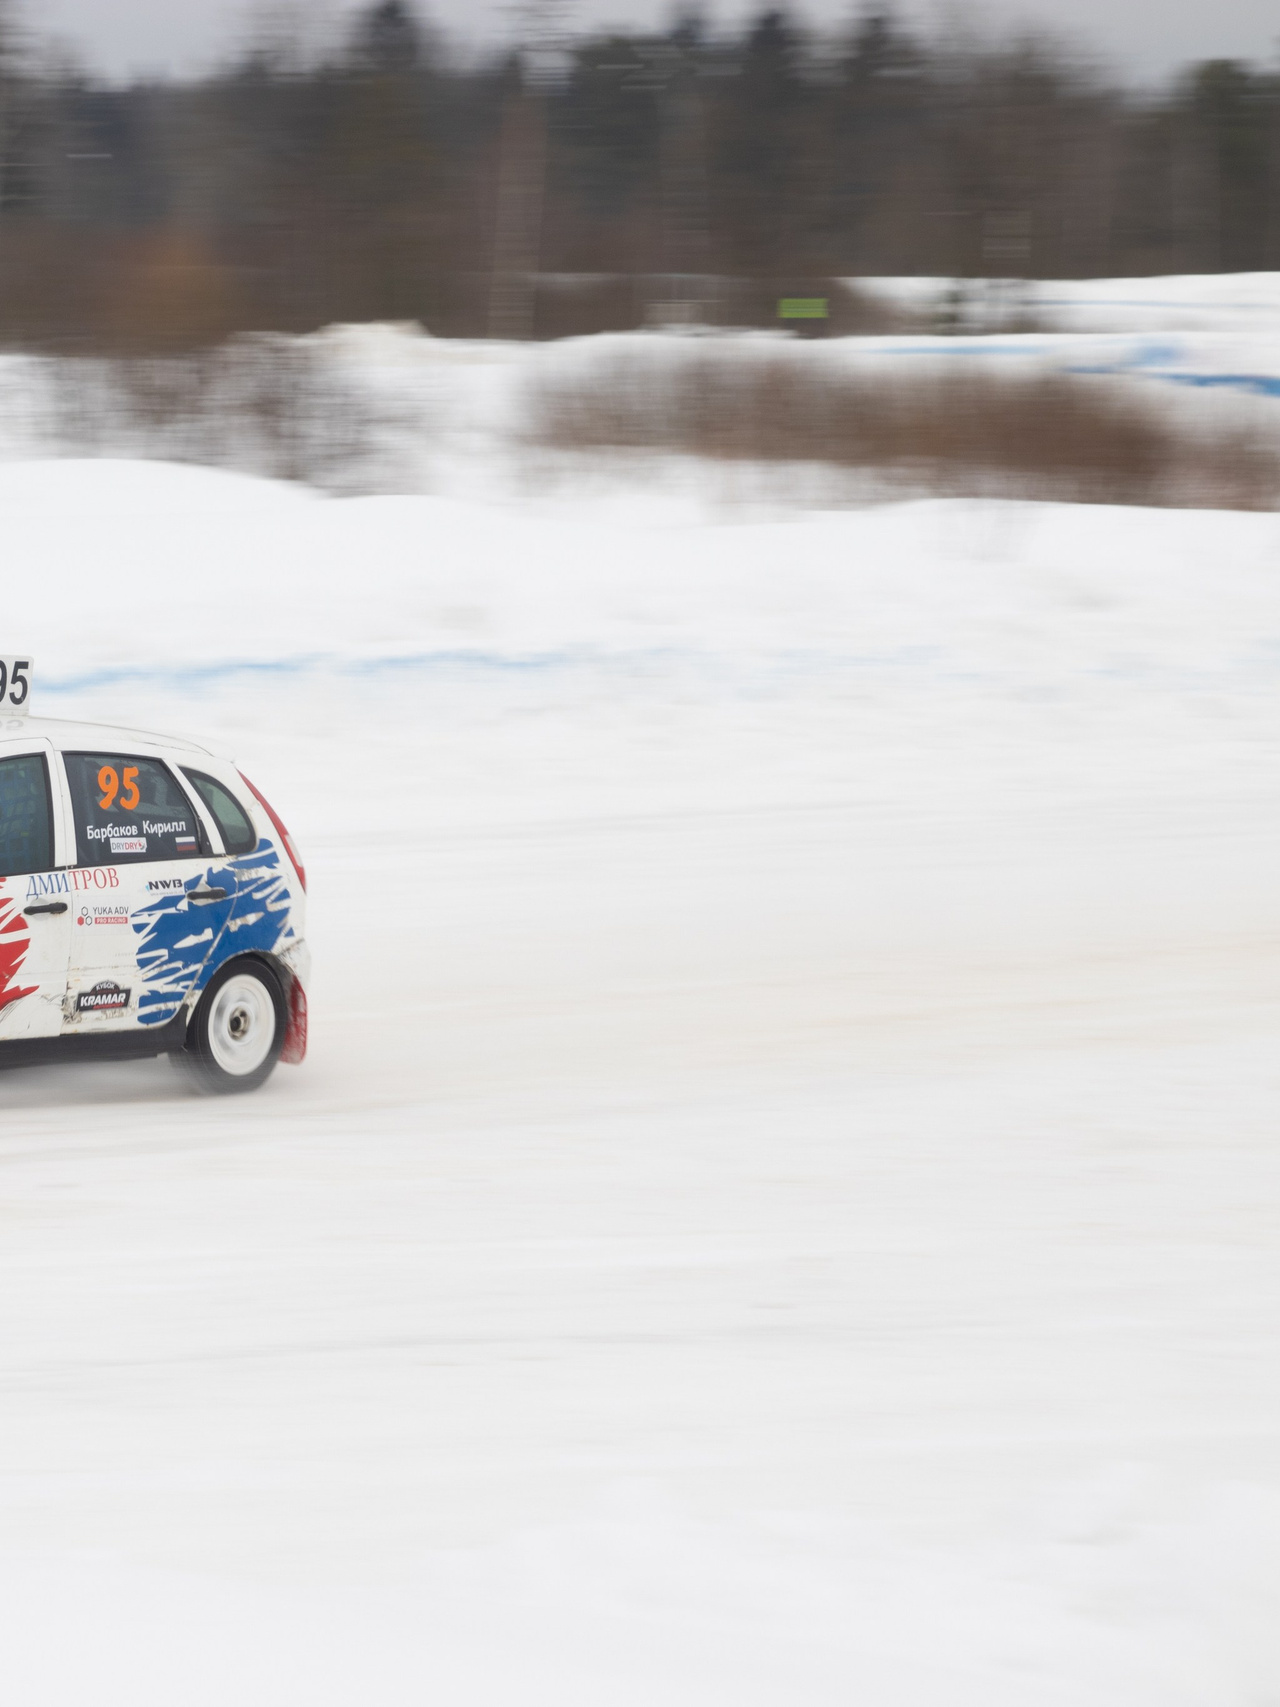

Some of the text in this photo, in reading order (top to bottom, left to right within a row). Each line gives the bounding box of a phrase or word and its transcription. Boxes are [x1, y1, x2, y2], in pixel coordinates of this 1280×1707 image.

[97, 766, 140, 810] 95
[86, 820, 187, 843] Барбаков Кирилл
[112, 842, 138, 850] DRYDRY
[26, 868, 120, 901] ДМИТРОВ
[148, 879, 183, 890] NWB
[93, 906, 129, 915] YUKA ADV
[80, 993, 127, 1007] KRAMAR
